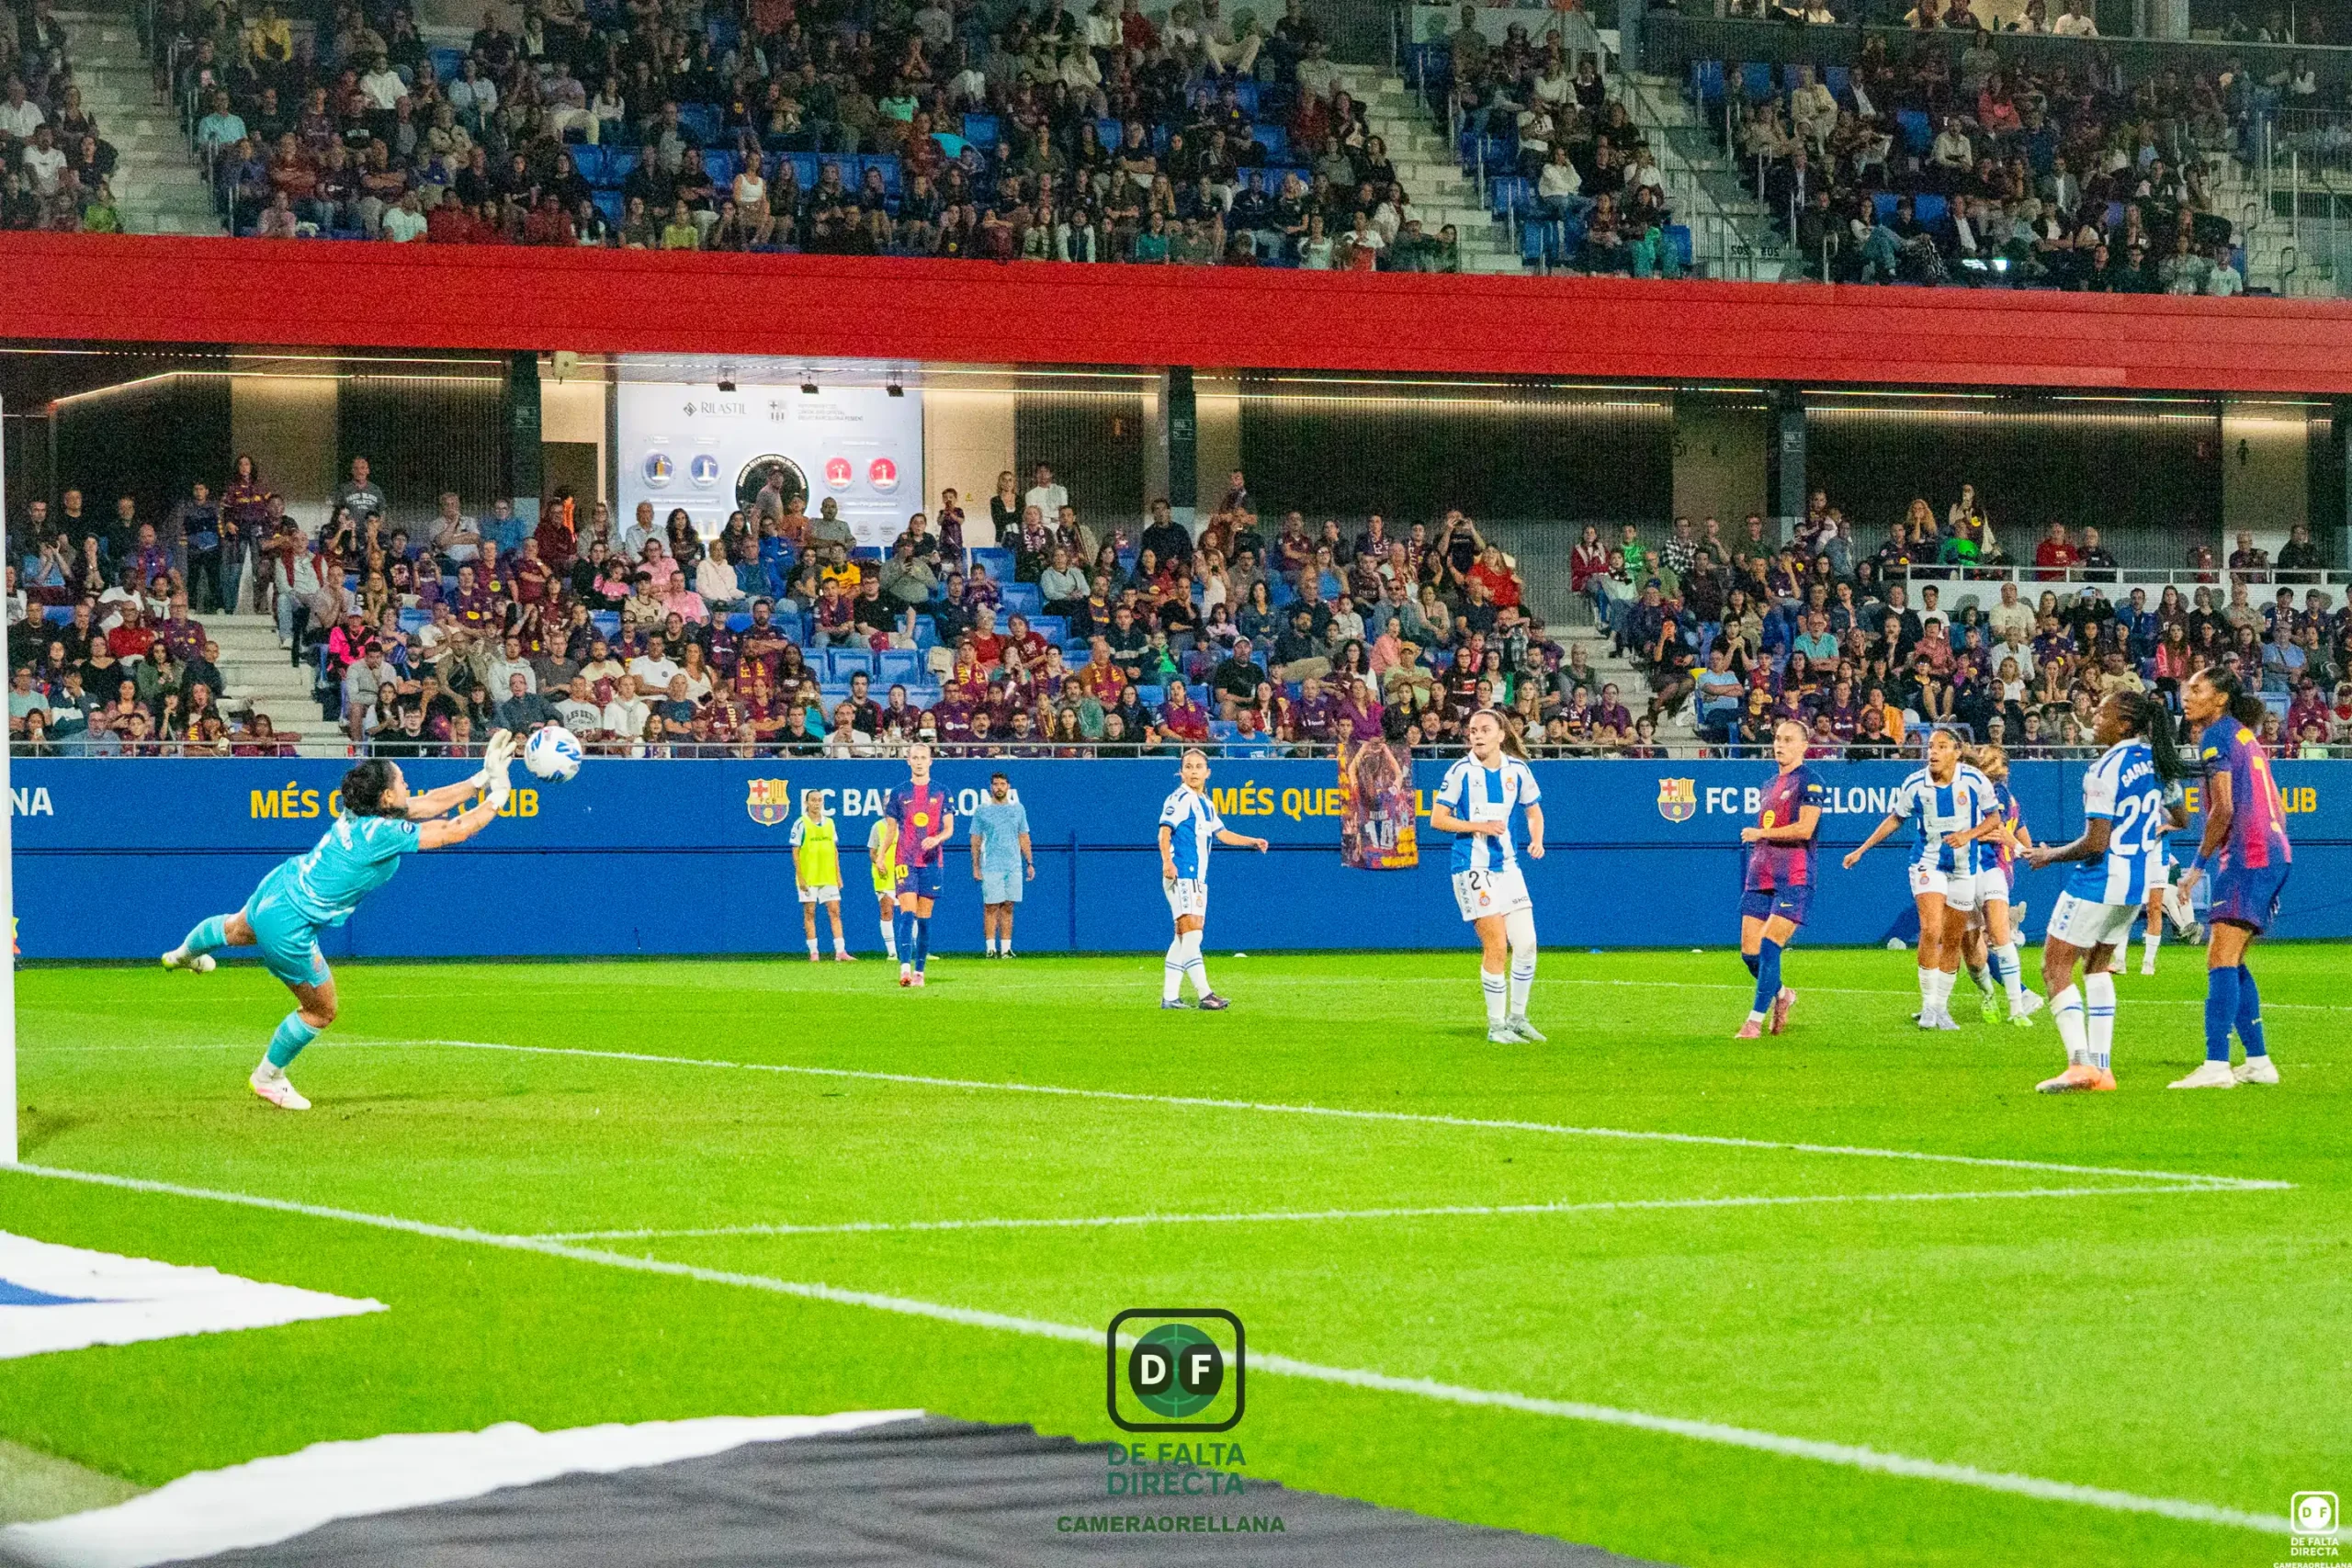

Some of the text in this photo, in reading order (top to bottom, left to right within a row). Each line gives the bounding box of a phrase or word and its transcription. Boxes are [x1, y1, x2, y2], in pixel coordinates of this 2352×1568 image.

[701, 401, 747, 414] RILASTIL
[251, 781, 320, 818] MÉS
[1212, 780, 1341, 821] MÉS QUE
[1706, 787, 1900, 814] FC BELONA
[2110, 788, 2162, 856] 22
